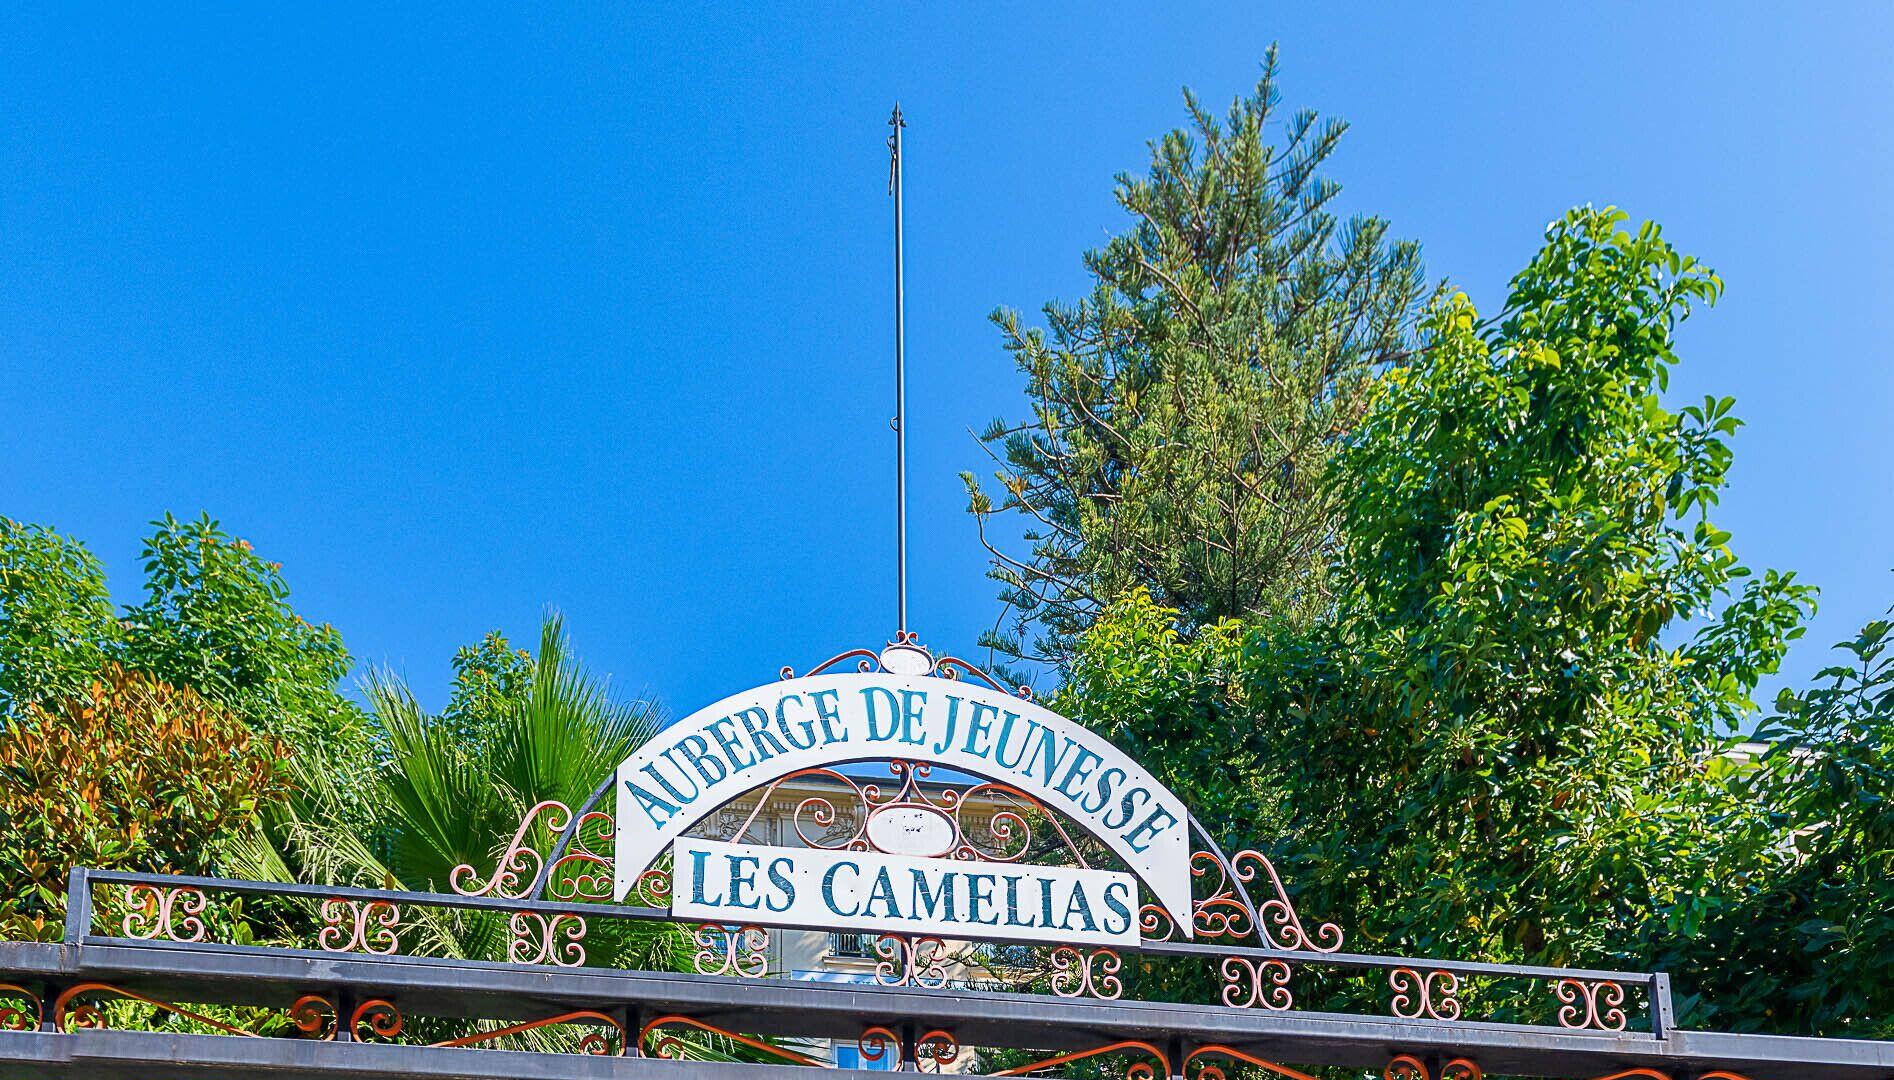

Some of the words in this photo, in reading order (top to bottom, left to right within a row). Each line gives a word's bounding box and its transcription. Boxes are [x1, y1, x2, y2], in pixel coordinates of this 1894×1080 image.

[624, 690, 848, 829] AUBERGE
[859, 686, 928, 745] DE
[934, 694, 1179, 853] JEUNESSE
[688, 850, 796, 912] LES
[821, 861, 1133, 935] CAMELIAS
